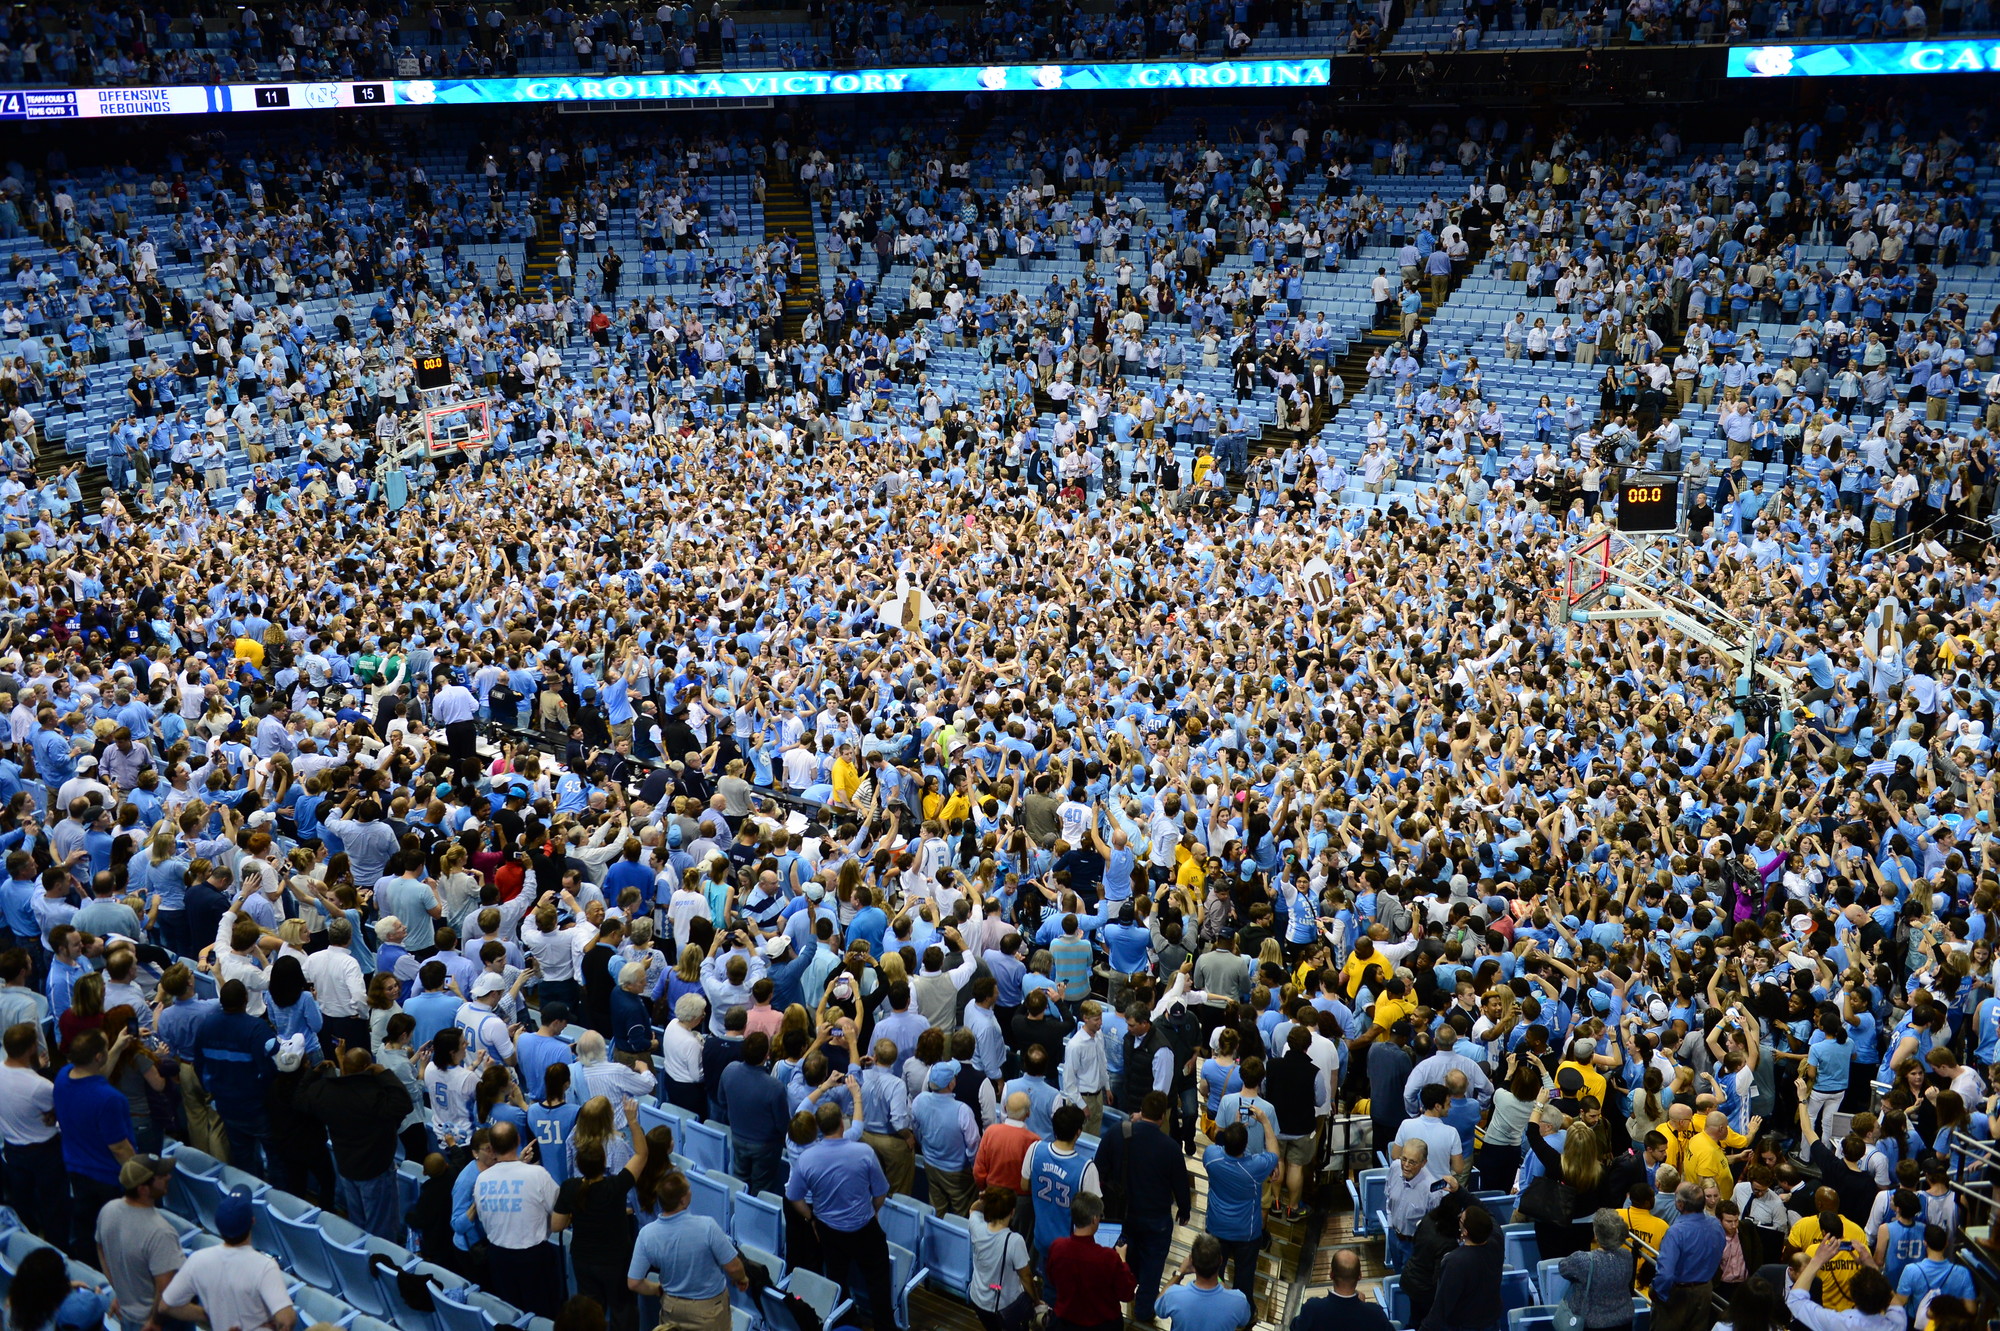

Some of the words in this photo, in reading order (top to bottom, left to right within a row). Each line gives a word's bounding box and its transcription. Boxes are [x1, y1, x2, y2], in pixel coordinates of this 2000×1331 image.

[1138, 66, 1328, 87] CAROLINA
[362, 87, 374, 100] 15
[526, 79, 726, 99] CAROLINA
[741, 73, 908, 94] VICTORY
[26, 95, 44, 103] TEAM
[45, 94, 66, 103] FOULS
[67, 93, 74, 103] 8
[98, 89, 169, 102] OFFENSIVE
[265, 91, 277, 103] 11
[0, 95, 20, 112] 74
[28, 107, 45, 116] TIME
[45, 106, 66, 115] OUTS
[69, 106, 75, 116] 1
[100, 102, 170, 115] REBOUNDS
[424, 358, 443, 370] 00.0
[1628, 487, 1662, 503] 00.0
[1808, 561, 1820, 576] 3
[1148, 719, 1162, 731] 40
[564, 780, 581, 793] 43
[1064, 808, 1082, 823] 40
[938, 855, 945, 870] 5
[435, 1081, 448, 1108] 5
[536, 1119, 563, 1145] 31
[1042, 1162, 1068, 1180] JORDAN
[479, 1180, 525, 1196] BEAT
[1037, 1175, 1070, 1208] 23
[481, 1197, 523, 1213] DUKE
[1896, 1239, 1922, 1260] 50
[1820, 1259, 1860, 1271] SECURITY
